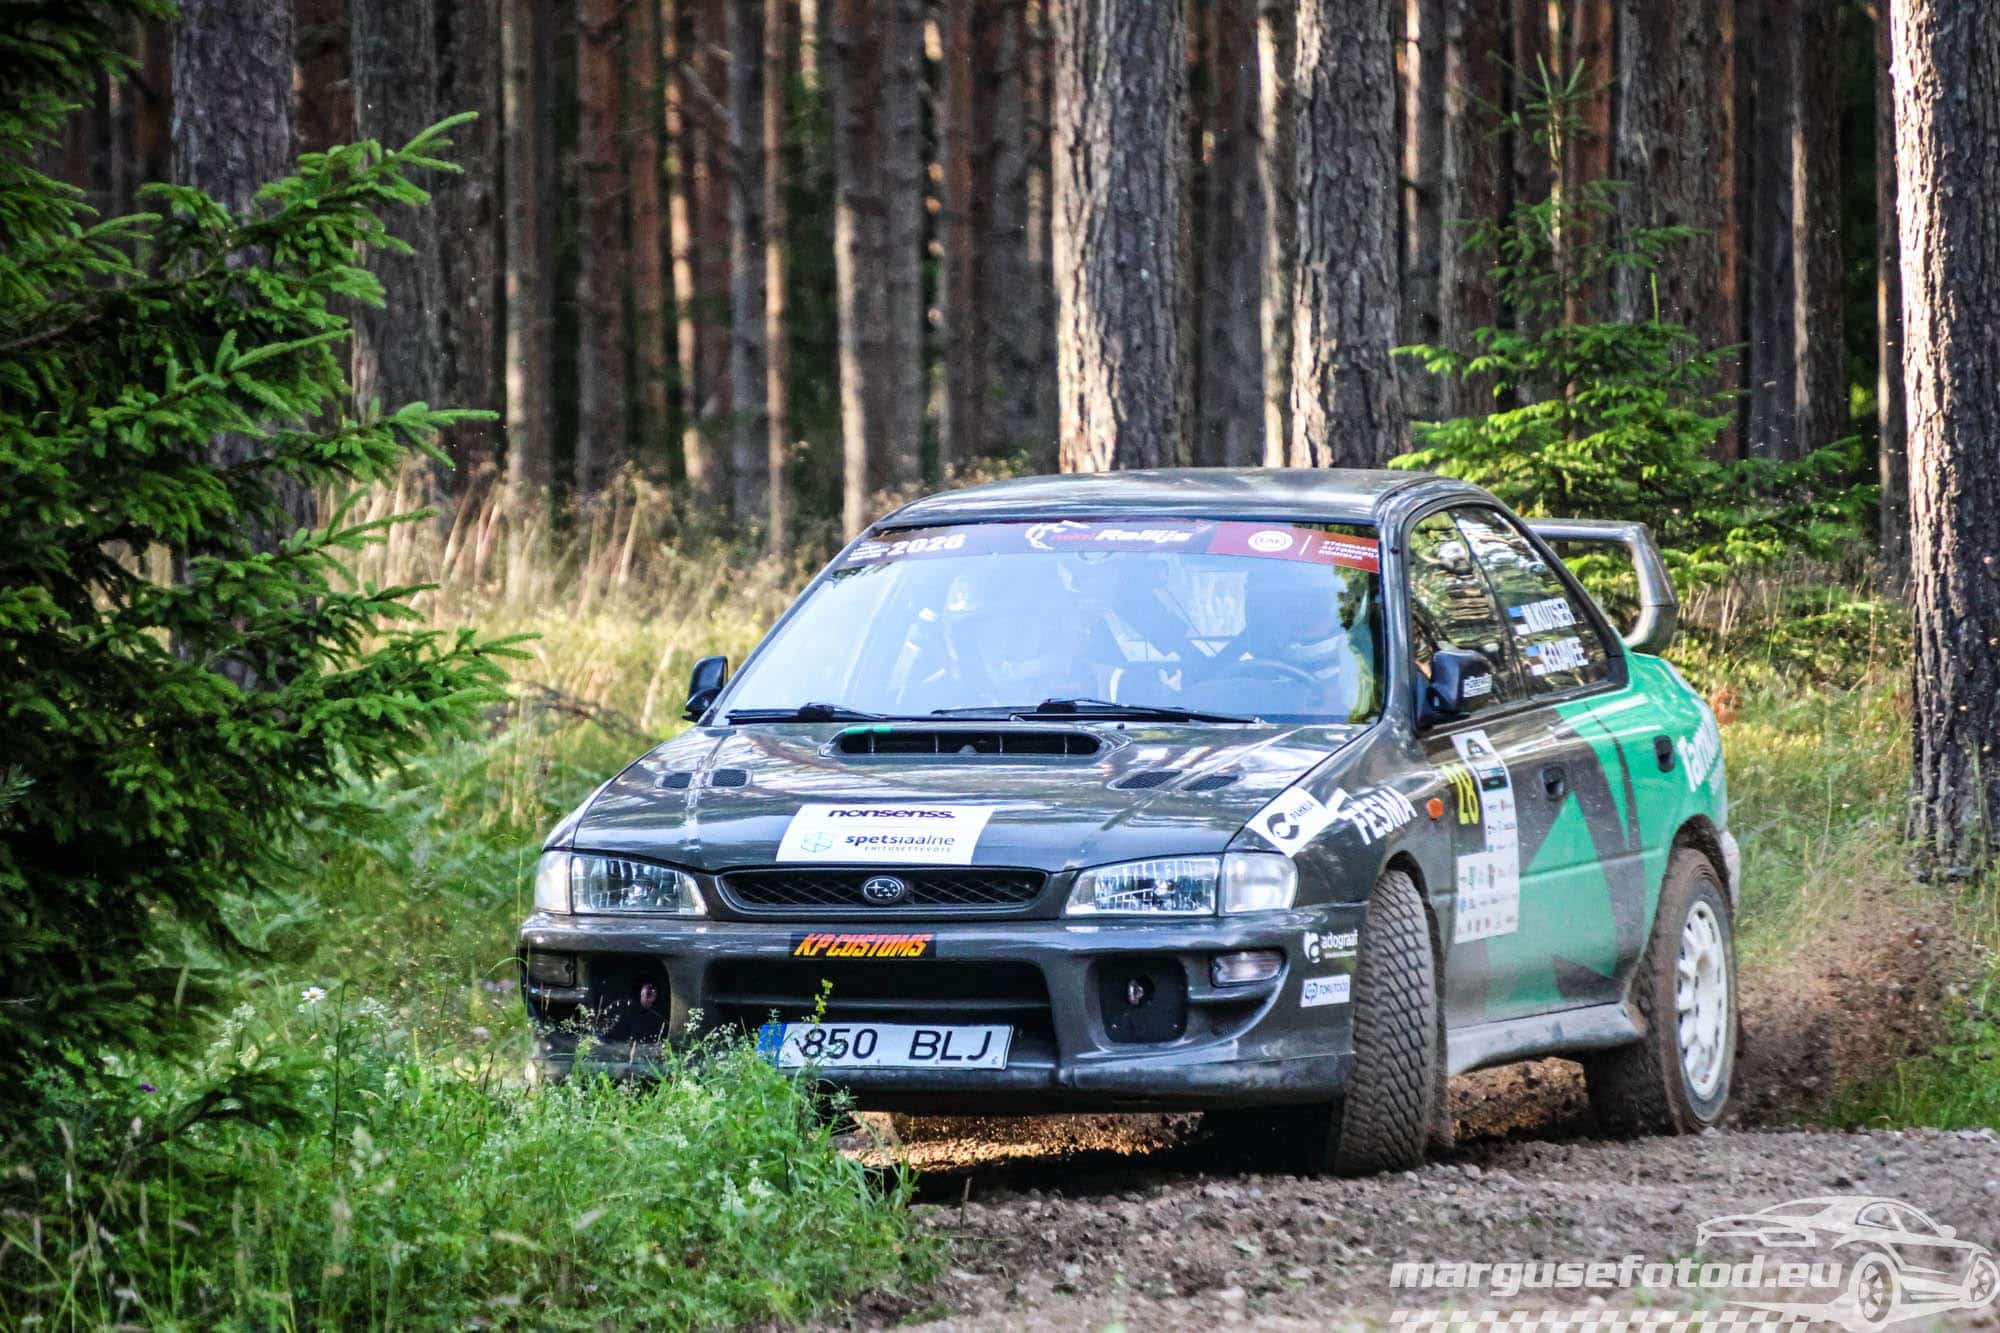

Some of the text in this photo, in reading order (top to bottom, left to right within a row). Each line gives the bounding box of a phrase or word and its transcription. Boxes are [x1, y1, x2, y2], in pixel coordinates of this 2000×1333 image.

[845, 834, 956, 847] spetsiaalne
[802, 1028, 879, 1060] 850
[908, 1030, 993, 1061] BLJ
